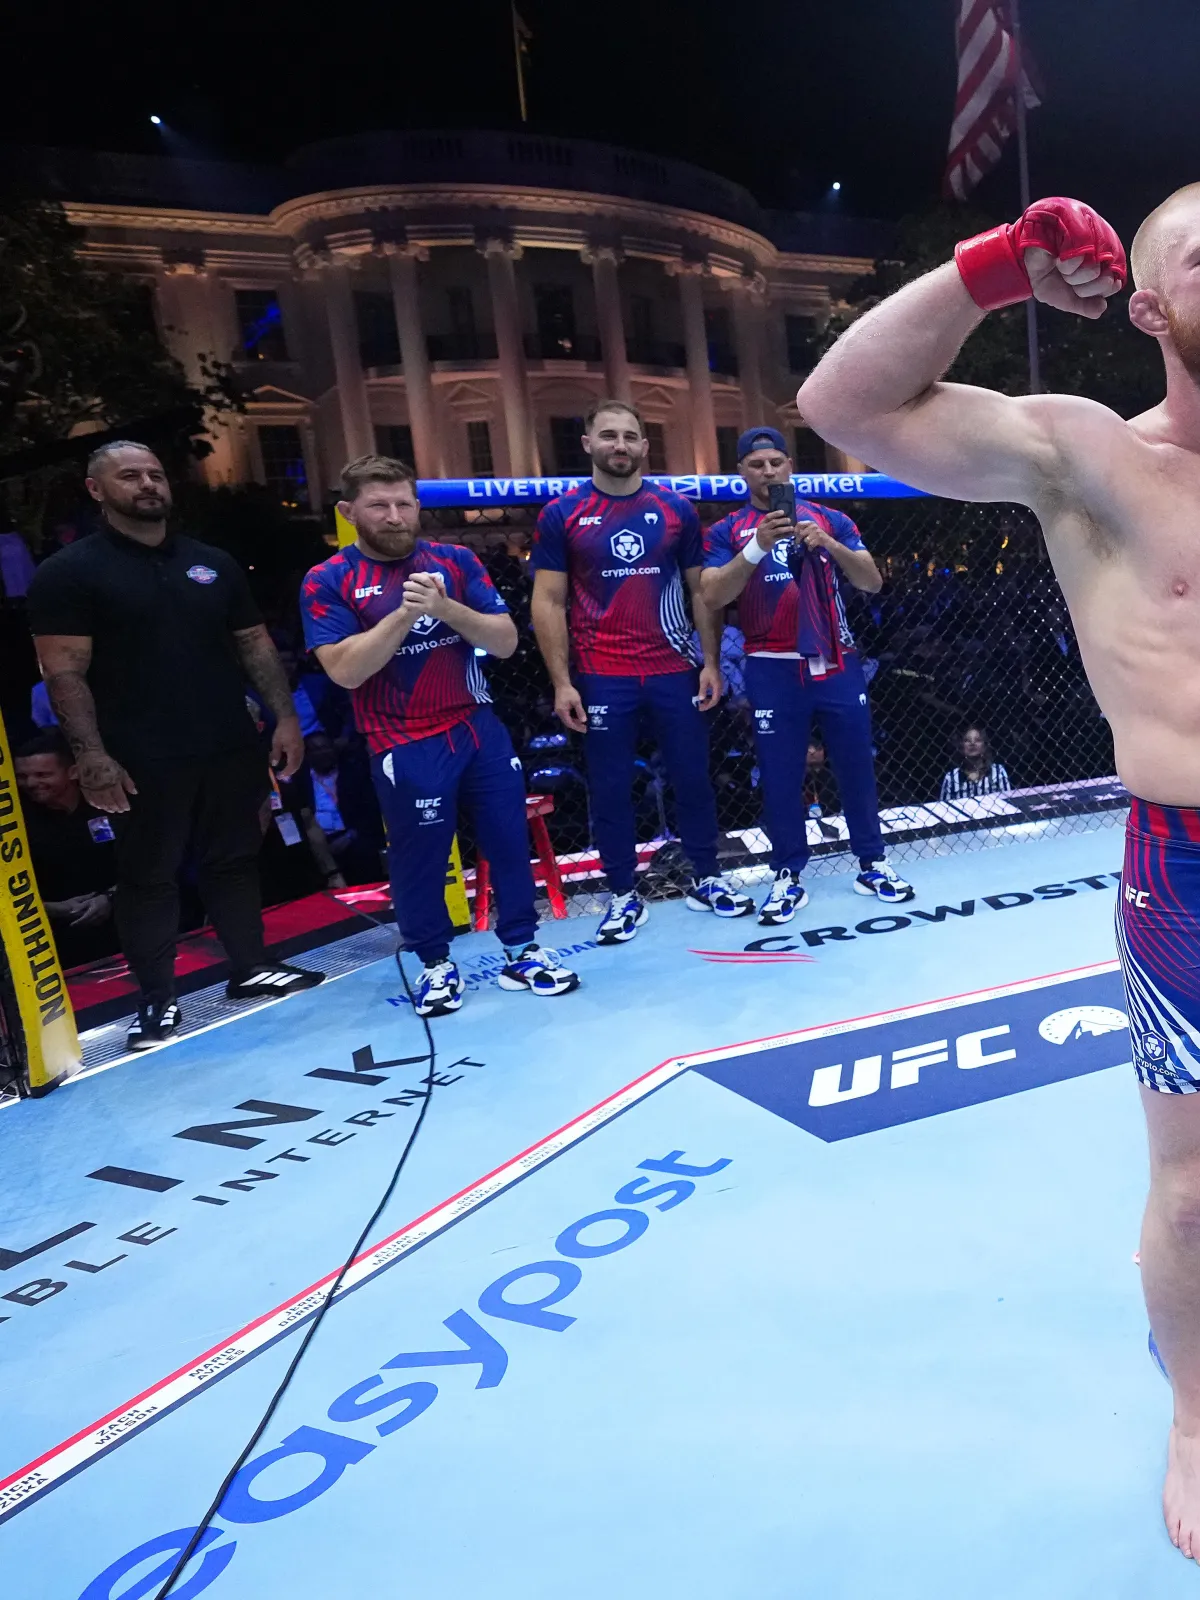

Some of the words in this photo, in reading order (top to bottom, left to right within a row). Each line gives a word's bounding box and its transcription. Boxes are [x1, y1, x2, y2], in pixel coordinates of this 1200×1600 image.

[579, 516, 602, 526] UFC
[601, 566, 661, 578] crypto.com
[354, 585, 383, 599] UFC
[587, 705, 609, 715] UFC
[754, 709, 774, 718] UFC
[415, 796, 442, 808] UFC
[8, 869, 67, 1027] NOTHING
[808, 1024, 1018, 1108] UFC
[1135, 1055, 1181, 1080] crypto.com
[0, 1221, 179, 1324] BLE
[191, 1056, 486, 1206] INTERNET
[450, 1181, 503, 1216] UNGEMACH
[457, 1187, 483, 1206] GREG
[372, 1230, 427, 1267] MICHAELS
[373, 1234, 411, 1260] ELIJAH
[284, 1291, 323, 1316] JERRY
[78, 1148, 733, 1600] easypost
[188, 1347, 236, 1378] MARIO
[197, 1349, 246, 1381] AVILES
[94, 1405, 159, 1446] WILSON
[96, 1408, 141, 1437] ZACH
